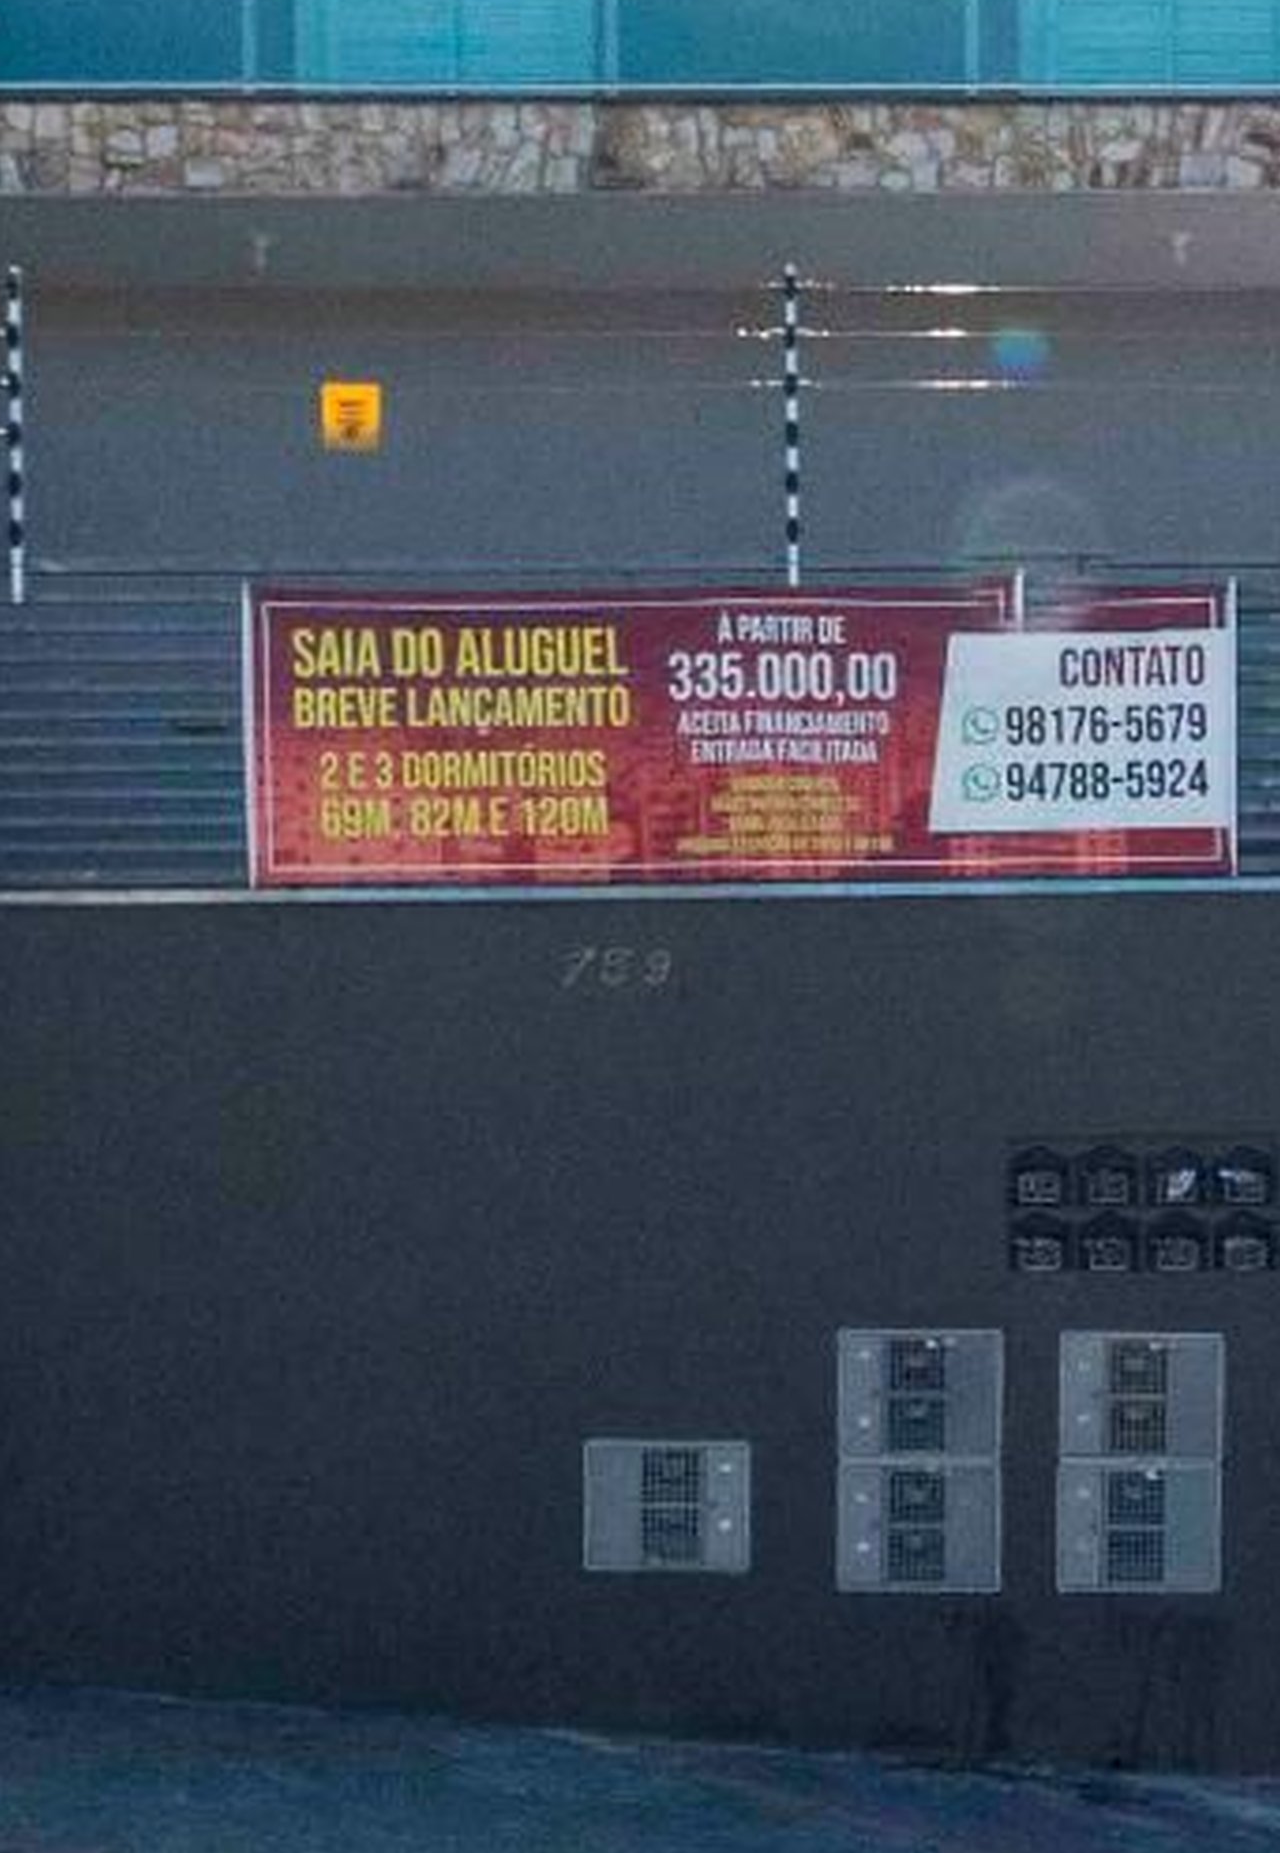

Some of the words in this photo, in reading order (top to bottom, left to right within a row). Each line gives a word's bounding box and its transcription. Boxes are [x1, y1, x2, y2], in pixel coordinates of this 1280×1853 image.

[737, 614, 814, 643] PARTIR
[818, 615, 847, 644] DE
[292, 628, 381, 678] SAIA
[391, 627, 444, 678] DO
[455, 626, 630, 677] ALUGUEL
[1059, 644, 1206, 686] CONTATO
[667, 651, 898, 706] 335.000,00
[293, 687, 400, 728] BREVE
[406, 685, 631, 736] LANÇAMENTO
[676, 711, 741, 734] ACEITA
[1005, 702, 1208, 746] 98176-5679
[320, 750, 339, 789] 2
[347, 751, 367, 788] E
[375, 750, 393, 789] 3
[401, 743, 607, 788] DORMITÓRIOS
[1005, 758, 1209, 802] 94788-5924
[489, 797, 509, 836] E
